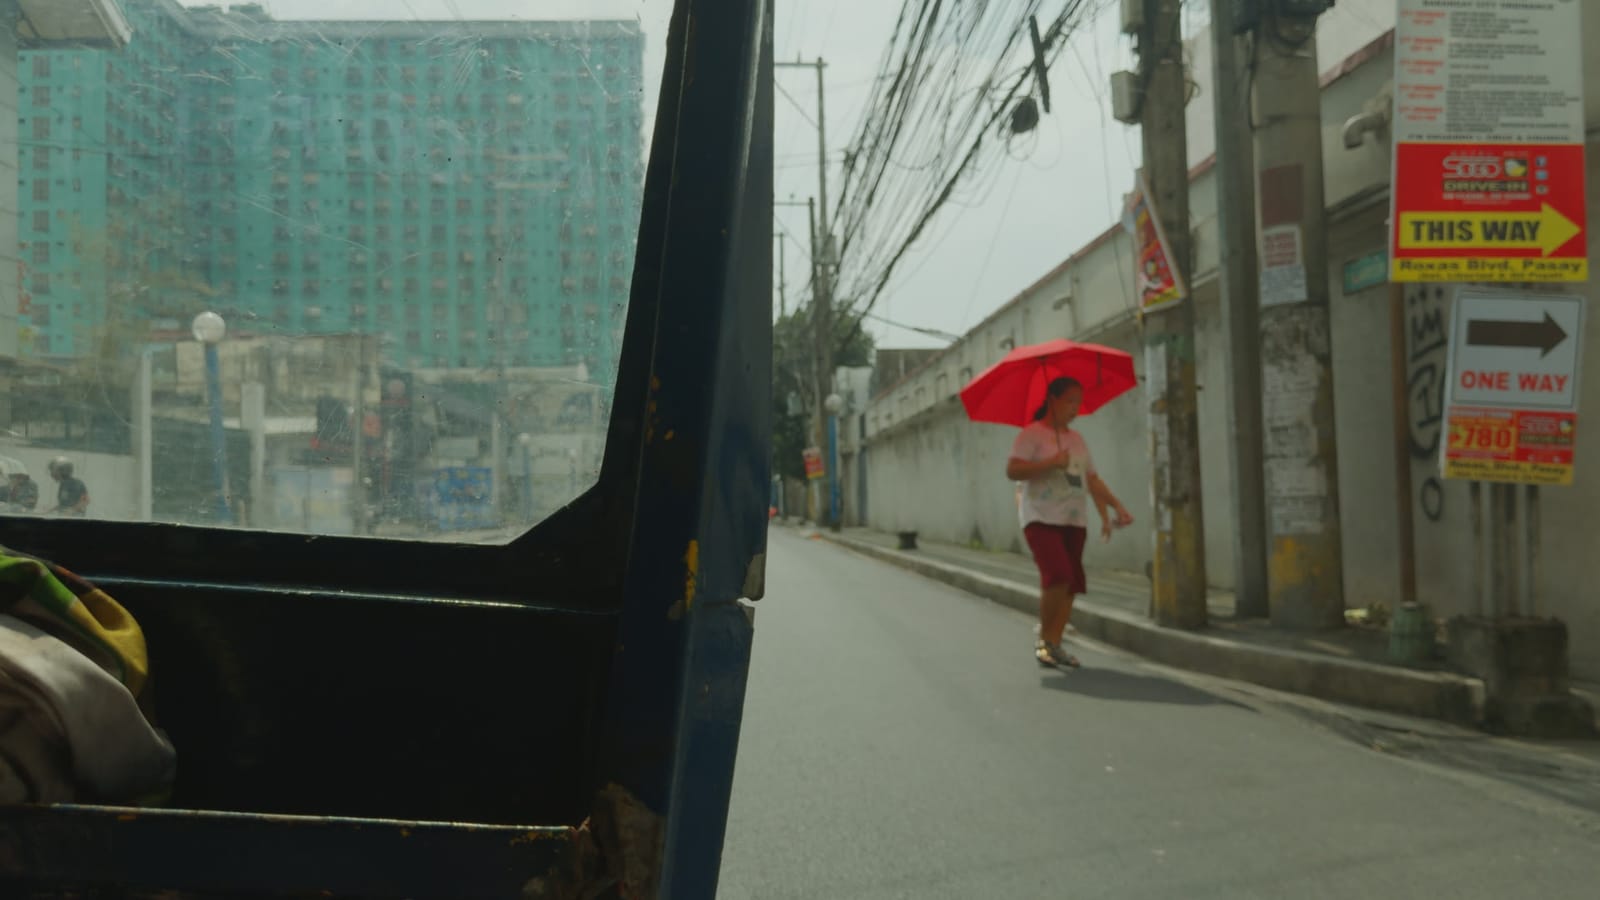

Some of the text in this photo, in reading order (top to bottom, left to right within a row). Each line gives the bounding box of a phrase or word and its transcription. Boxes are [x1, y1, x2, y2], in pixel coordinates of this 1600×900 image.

[1411, 220, 1541, 242] THIS WAY
[1400, 258, 1461, 270] Roxas
[1523, 259, 1582, 273] Pasay
[1461, 370, 1569, 392] ONE WAY
